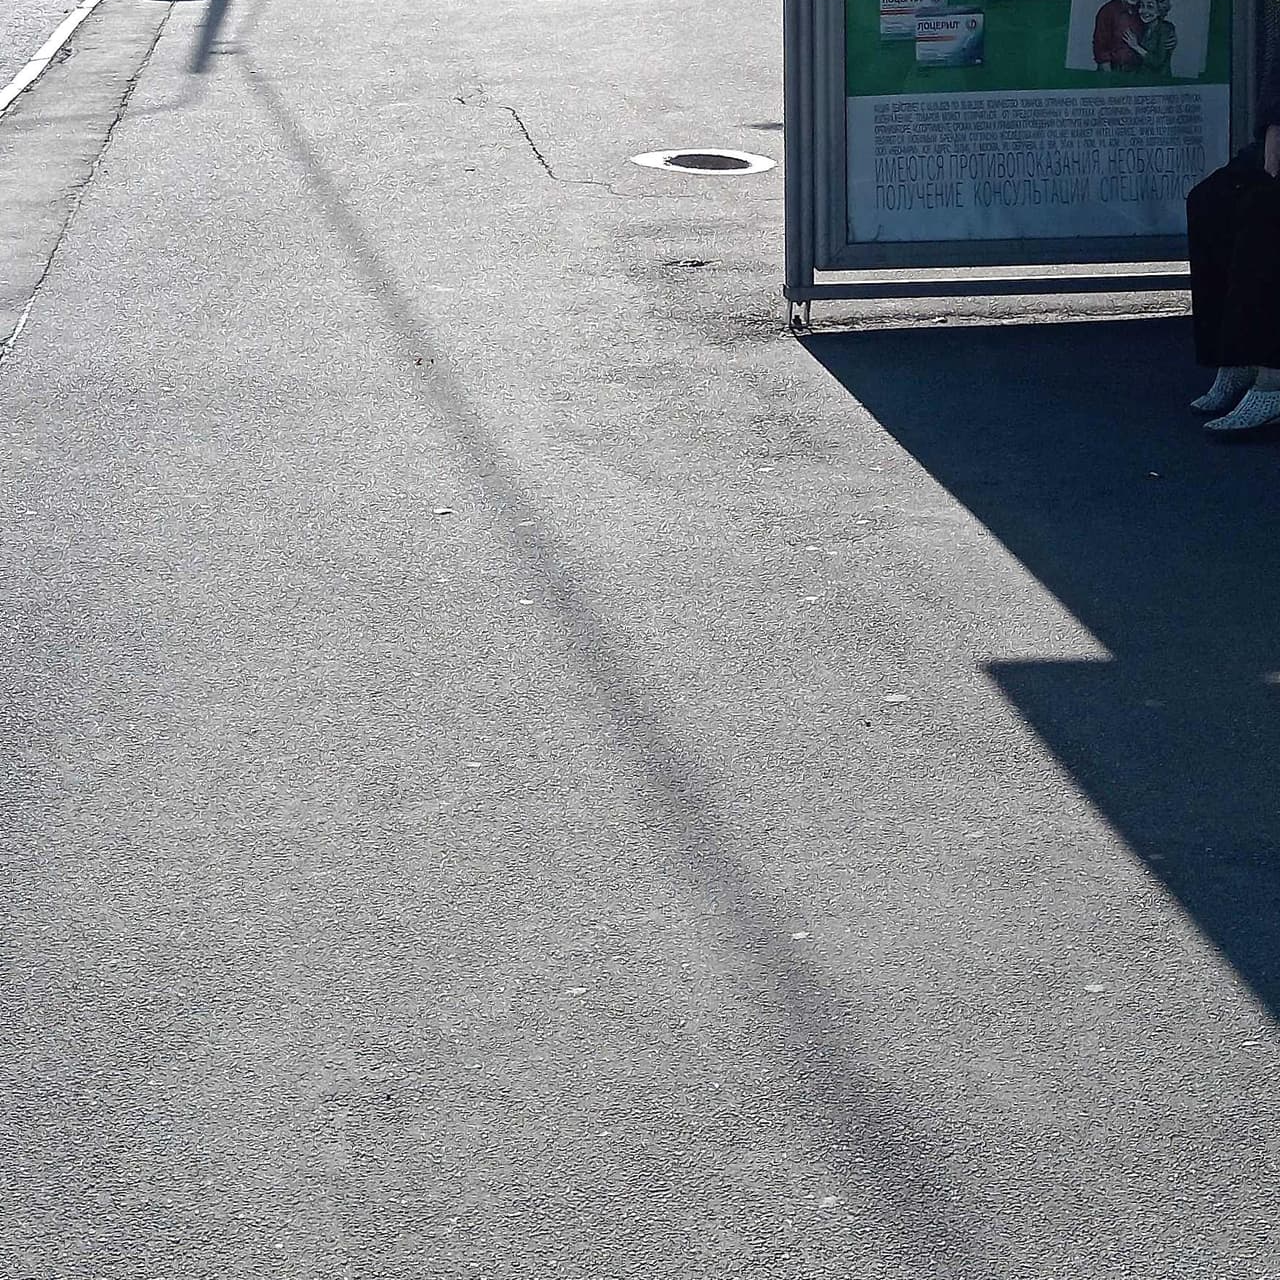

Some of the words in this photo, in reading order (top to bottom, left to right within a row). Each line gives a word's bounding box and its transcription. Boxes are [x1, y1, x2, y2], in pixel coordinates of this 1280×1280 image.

[875, 153, 944, 184] ИМЕЮТСЯ
[949, 148, 1104, 180] ПРОТИВОПОКАЗАНИЯ.
[1107, 145, 1206, 175] НЕОБХОДИМО
[875, 181, 964, 211] ПОЛУЧЕНИЕ
[973, 177, 1090, 208] КОНСУЛЬТАЦИИ
